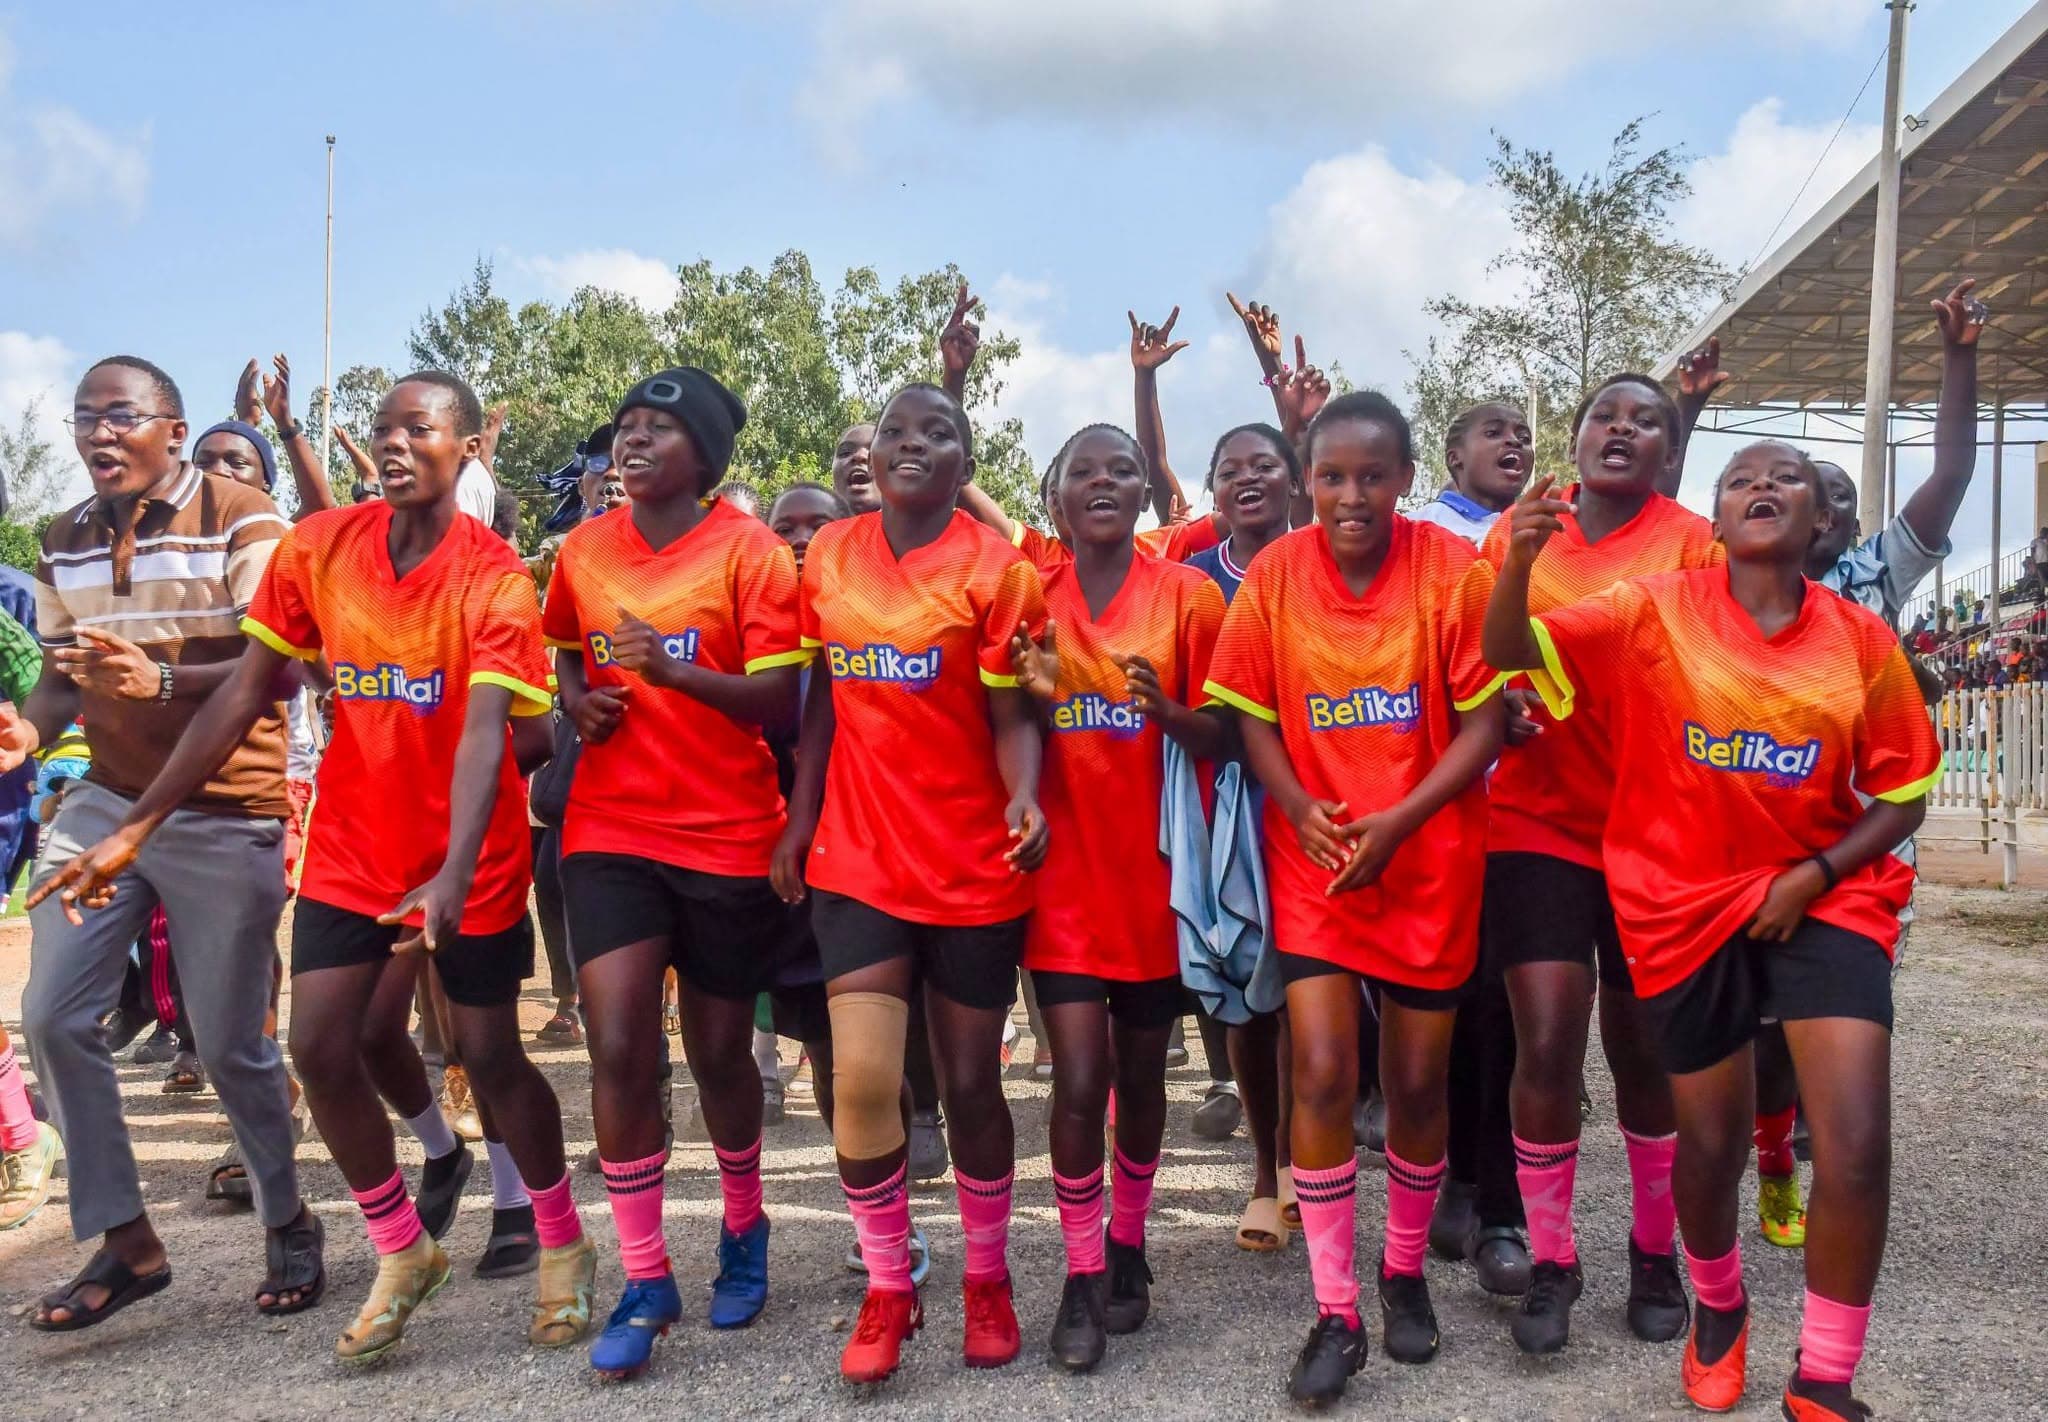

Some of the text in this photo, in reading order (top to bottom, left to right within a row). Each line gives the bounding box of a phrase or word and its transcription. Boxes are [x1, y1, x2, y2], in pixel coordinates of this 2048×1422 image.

[829, 646, 938, 679] Betika!
[335, 666, 442, 703] Betika!
[1049, 697, 1141, 729] etika!
[1309, 686, 1418, 727] Betika!
[1688, 726, 1817, 776] Betika!
